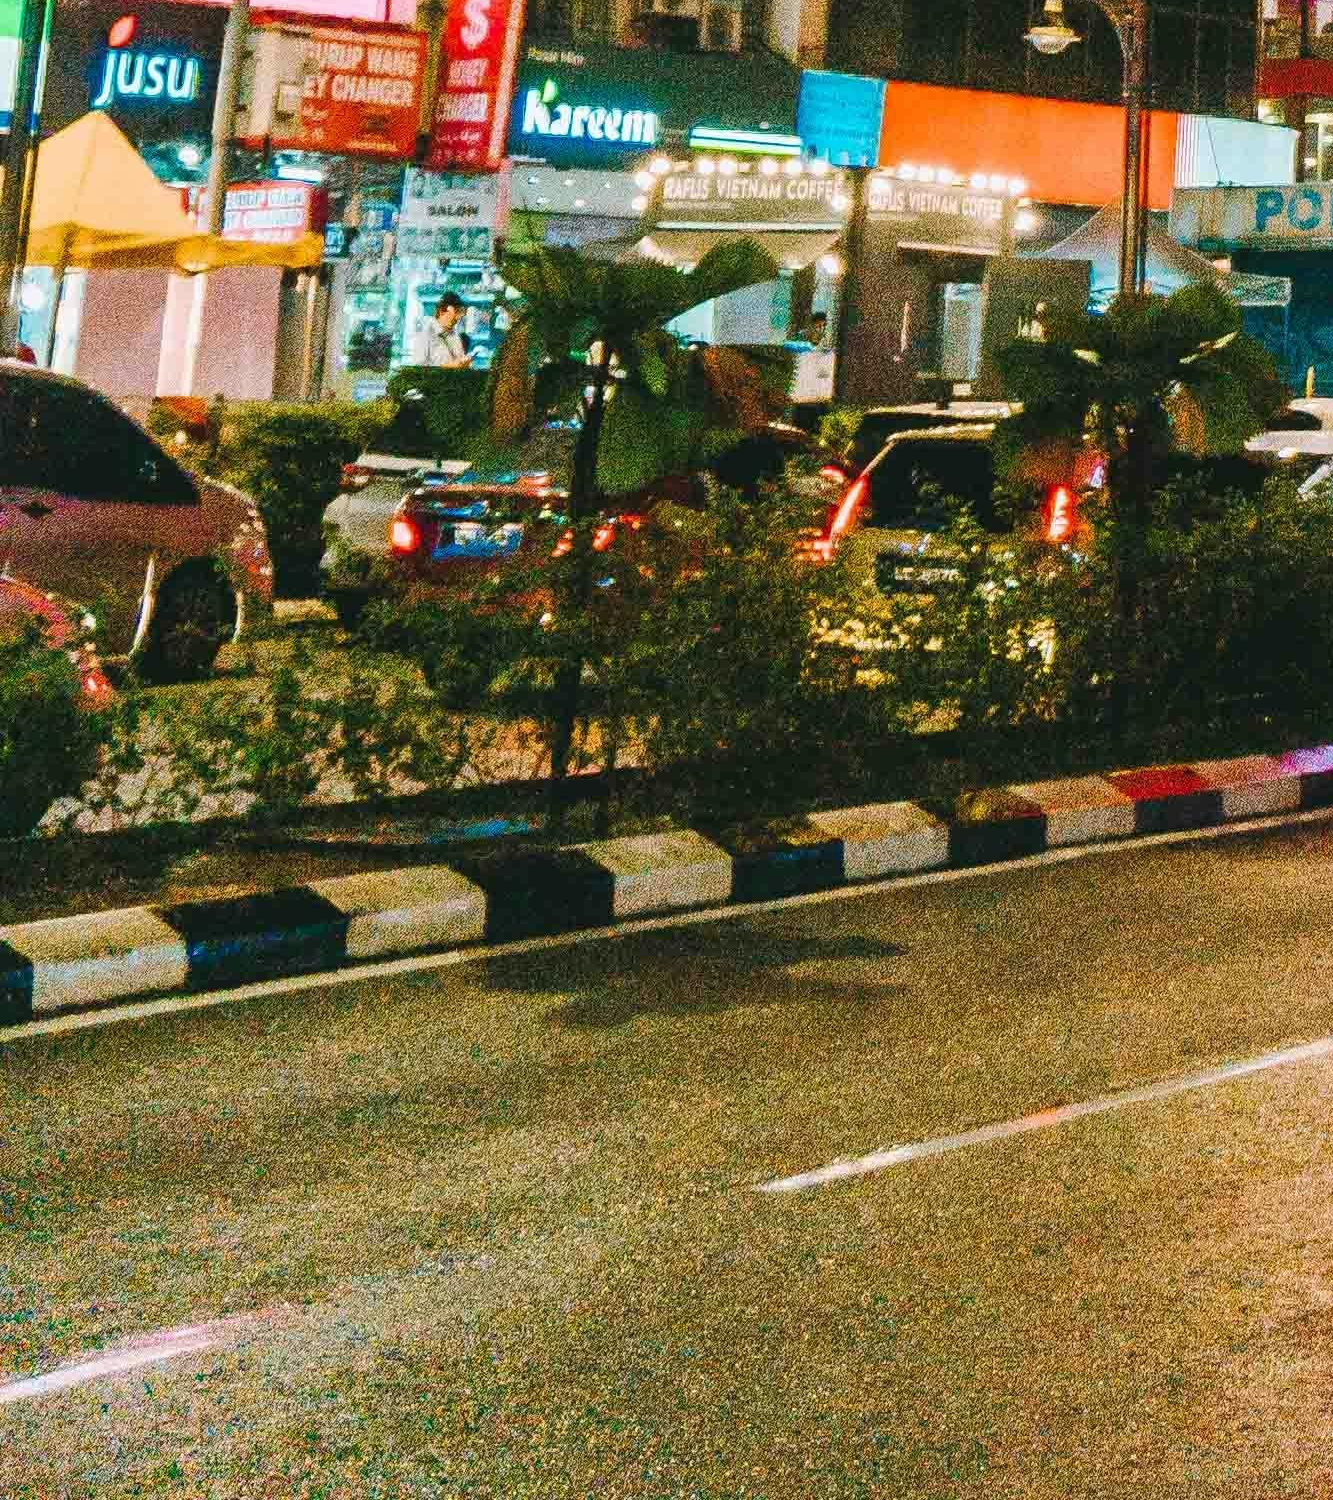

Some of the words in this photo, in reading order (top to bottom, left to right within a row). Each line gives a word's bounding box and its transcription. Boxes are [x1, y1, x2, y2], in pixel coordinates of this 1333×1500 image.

[91, 46, 200, 109] jusu
[522, 88, 659, 144] Kareem
[715, 178, 781, 200] VIETNAM
